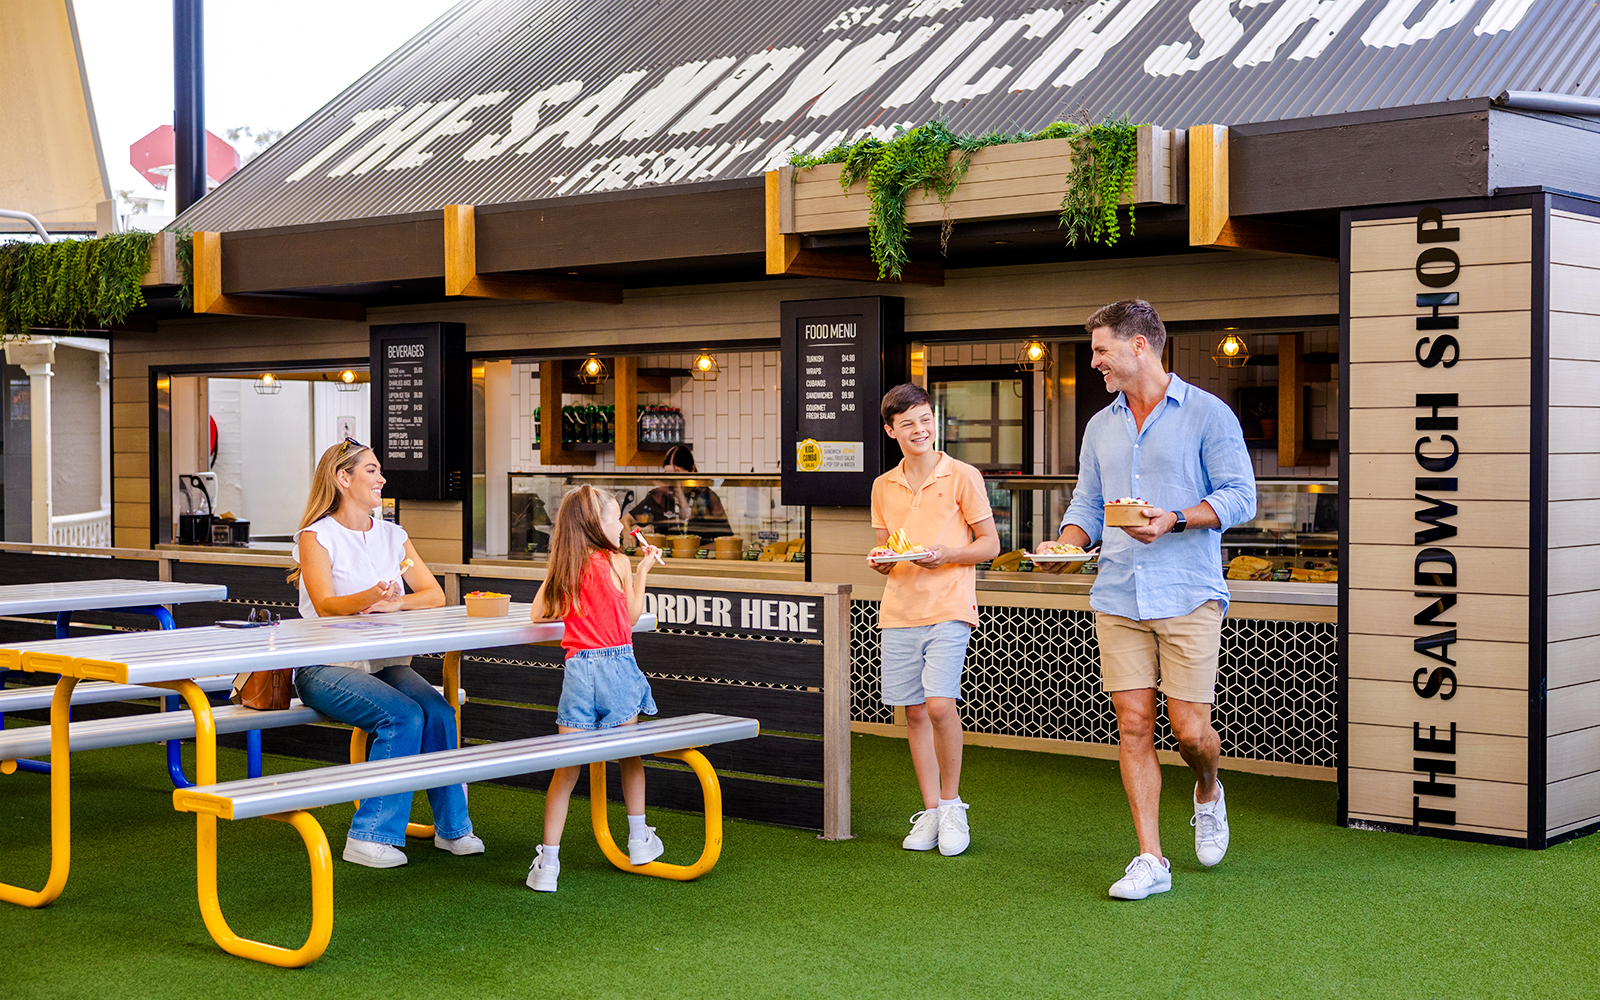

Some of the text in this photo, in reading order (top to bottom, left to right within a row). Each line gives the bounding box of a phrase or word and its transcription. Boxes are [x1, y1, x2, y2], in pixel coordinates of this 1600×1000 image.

[286, 89, 511, 183] THE
[465, 0, 1164, 162] SANDWICH
[555, 136, 764, 196] FRESHLY
[805, 323, 857, 340] FOOD MENU
[388, 344, 424, 358] BEVERAGES
[805, 355, 825, 363] TURKISH
[805, 367, 822, 375] WRAPS
[805, 379, 827, 387] CUBANOS
[805, 391, 834, 399] SANDWICHES
[805, 404, 827, 412] GOURMET
[805, 412, 837, 420] FRESH SALADS
[805, 445, 814, 453] KIDS
[1412, 206, 1461, 829] THE SANDWICH SHOP
[740, 598, 818, 633] HERE
